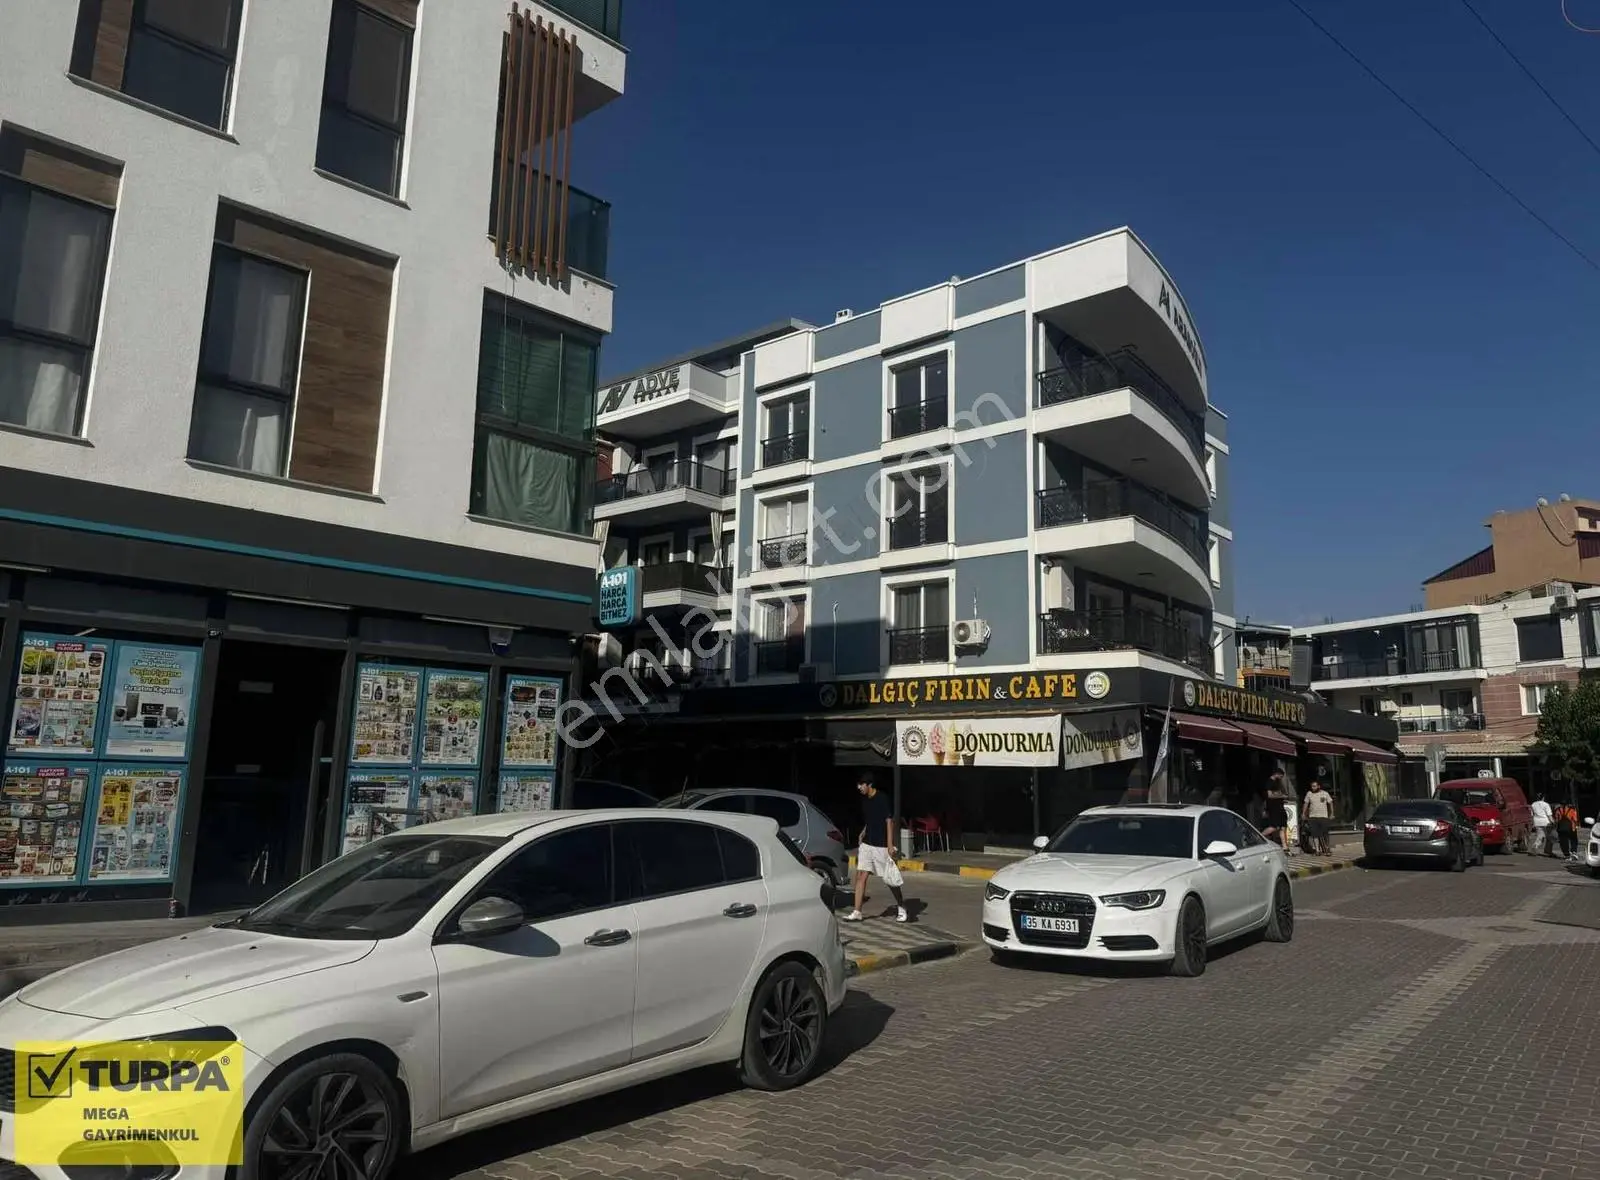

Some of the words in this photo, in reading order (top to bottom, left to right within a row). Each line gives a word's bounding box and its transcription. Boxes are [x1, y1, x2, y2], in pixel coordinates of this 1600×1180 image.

[601, 572, 628, 588] A-101
[601, 586, 627, 599] HARCA
[601, 597, 627, 610] HARCA
[842, 680, 919, 708] DALGIÇ
[925, 678, 991, 701] FIRIN
[1009, 674, 1077, 699] CAFE
[1198, 683, 1239, 713] DALGIÇ
[1240, 692, 1268, 716] FIRIN
[1273, 699, 1297, 722] CAFE
[954, 732, 1055, 753] DONDURMA
[1065, 730, 1121, 755] DONDURMA
[1027, 917, 1037, 928] 35
[1041, 919, 1052, 929] KA
[1055, 919, 1077, 931] 6931
